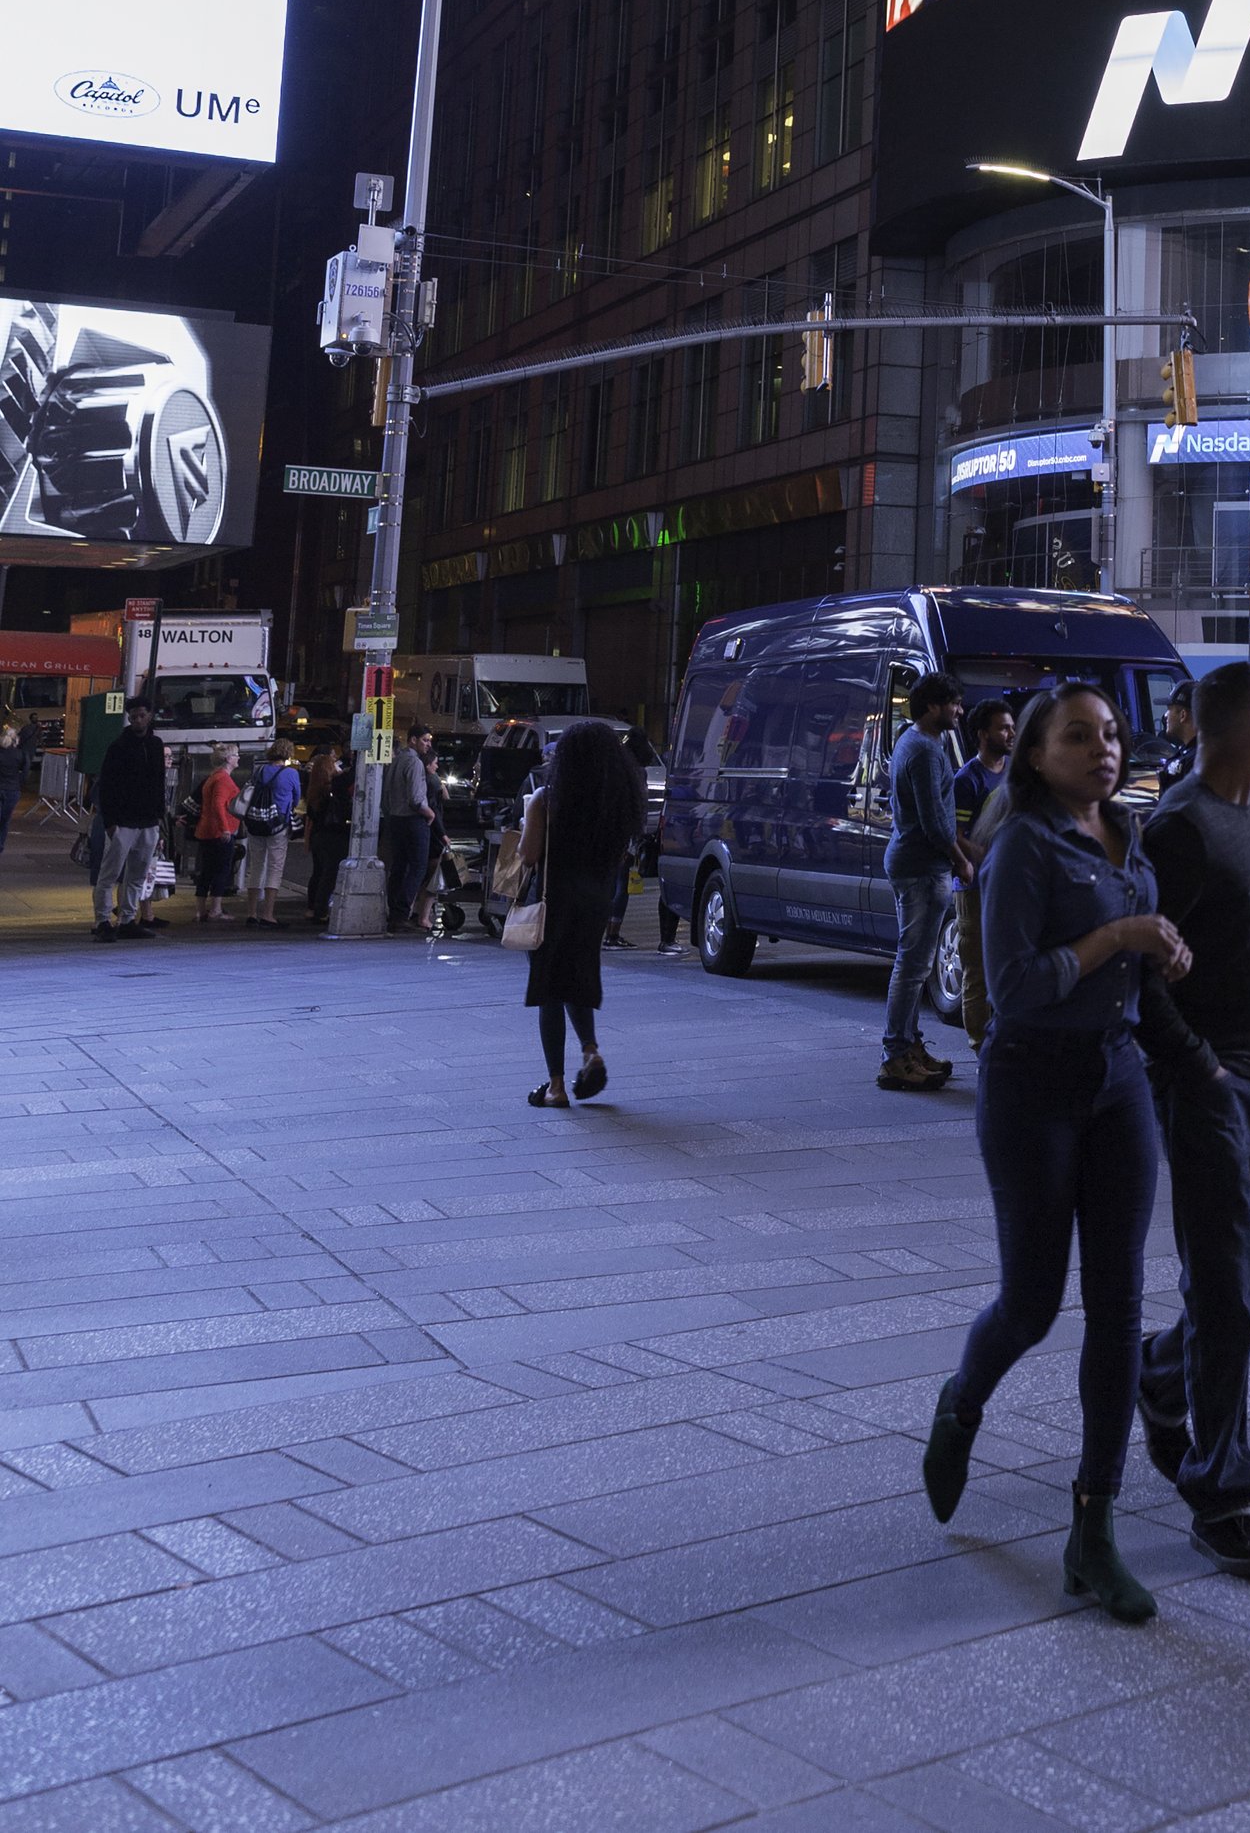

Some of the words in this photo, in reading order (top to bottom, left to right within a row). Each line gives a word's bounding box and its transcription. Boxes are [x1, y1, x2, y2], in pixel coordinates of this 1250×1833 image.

[69, 80, 145, 104] Capitol
[345, 283, 380, 298] 726156
[998, 449, 1017, 472] 50
[288, 469, 372, 494] BROADWAY
[162, 630, 233, 643] WALTON
[357, 622, 372, 631] Times
[372, 622, 391, 631] Square
[385, 697, 393, 731] HOLDING
